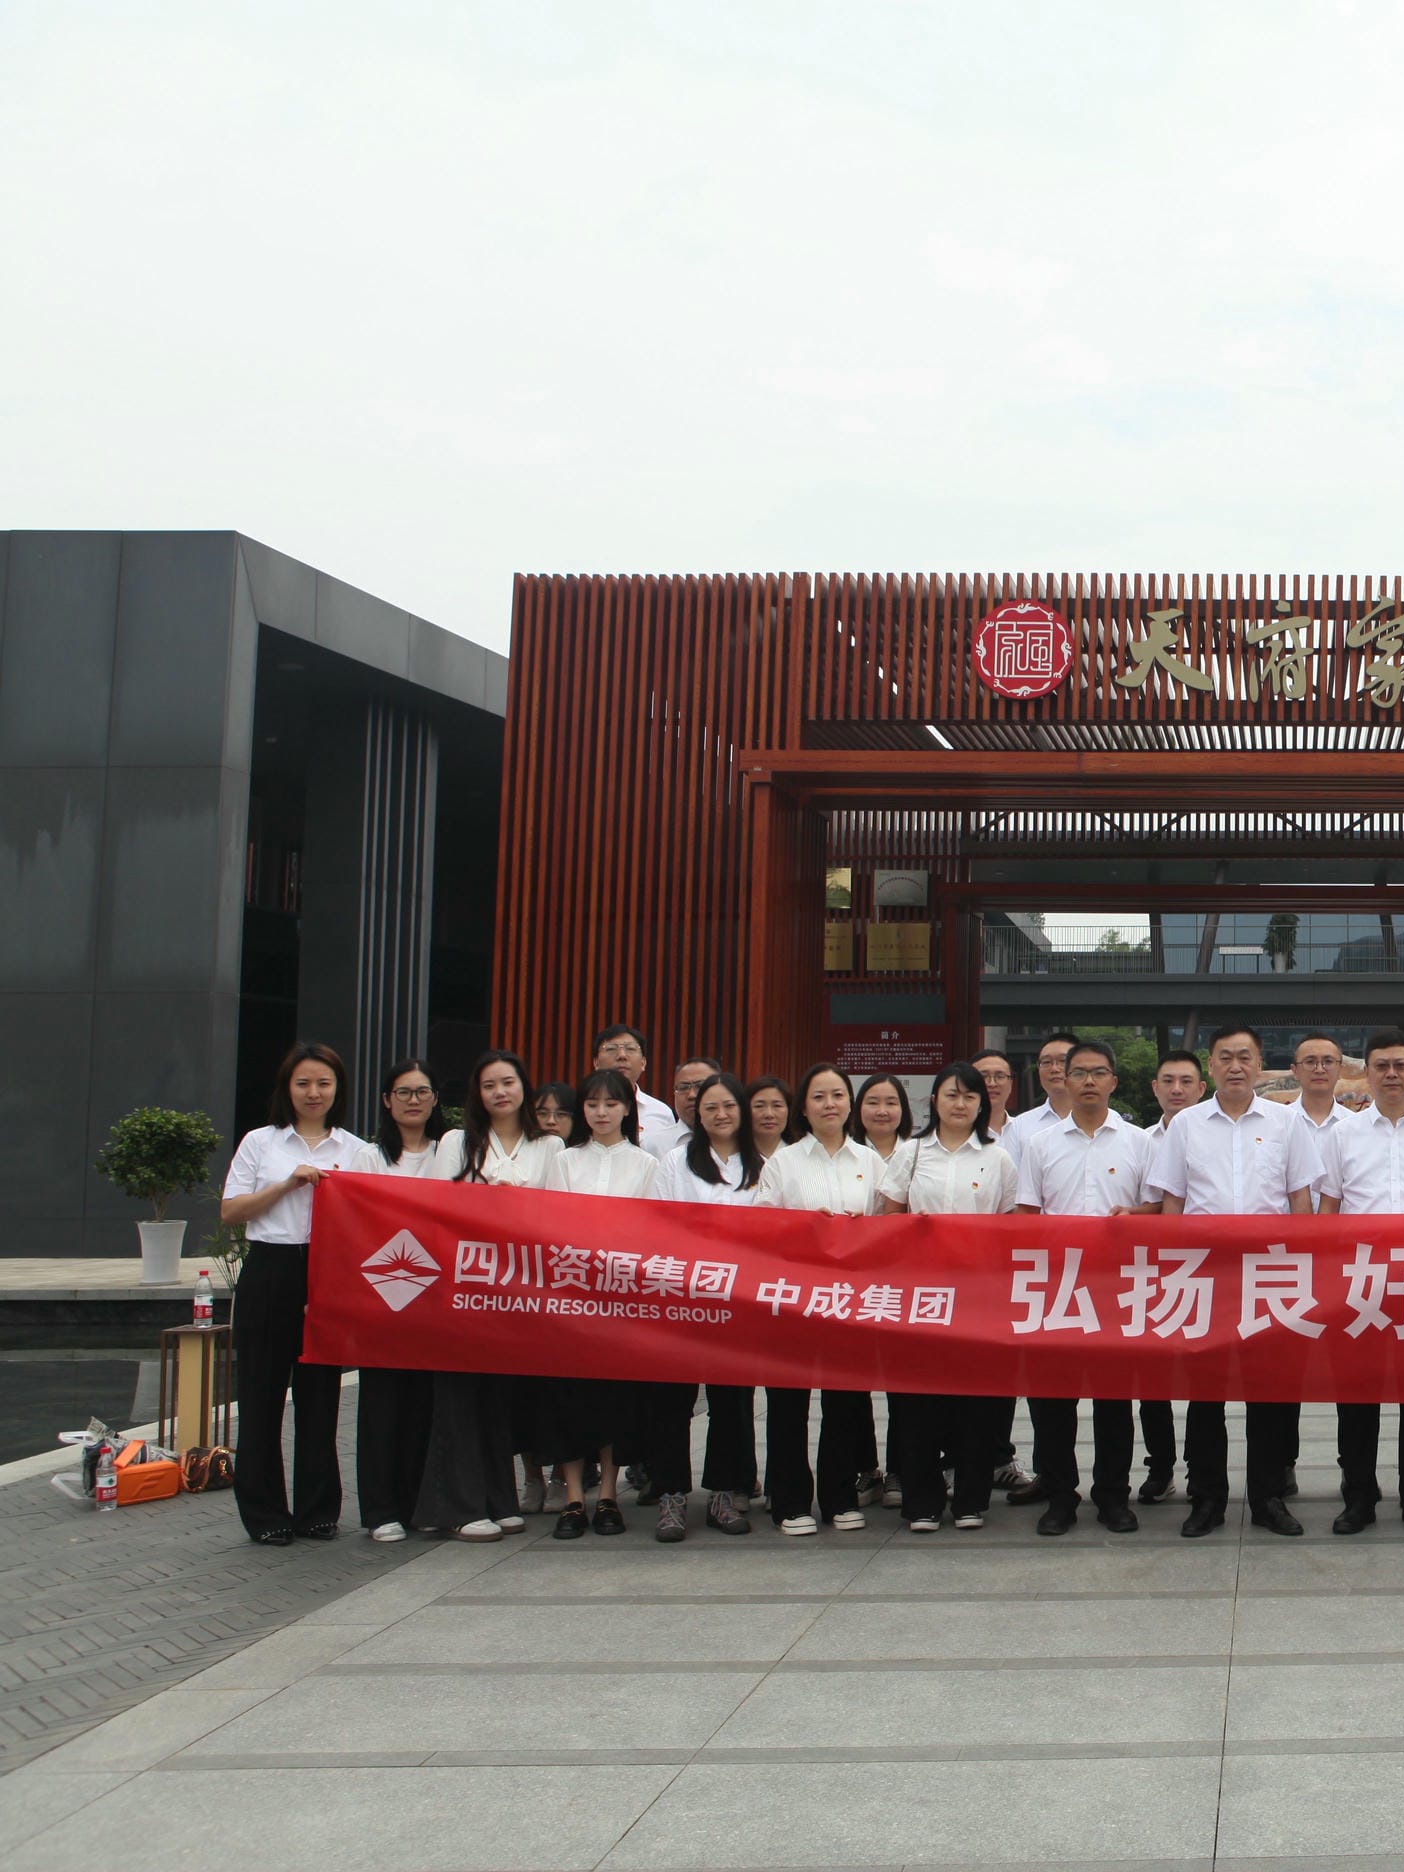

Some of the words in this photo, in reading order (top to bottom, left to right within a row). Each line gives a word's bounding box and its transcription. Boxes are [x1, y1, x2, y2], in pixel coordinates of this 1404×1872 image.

[452, 1292, 541, 1314] SICHUAN
[545, 1297, 662, 1321] RESOURCES
[666, 1305, 734, 1324] GROUP
[453, 1239, 740, 1302] 四川资源集团
[756, 1277, 957, 1327] 中成集团
